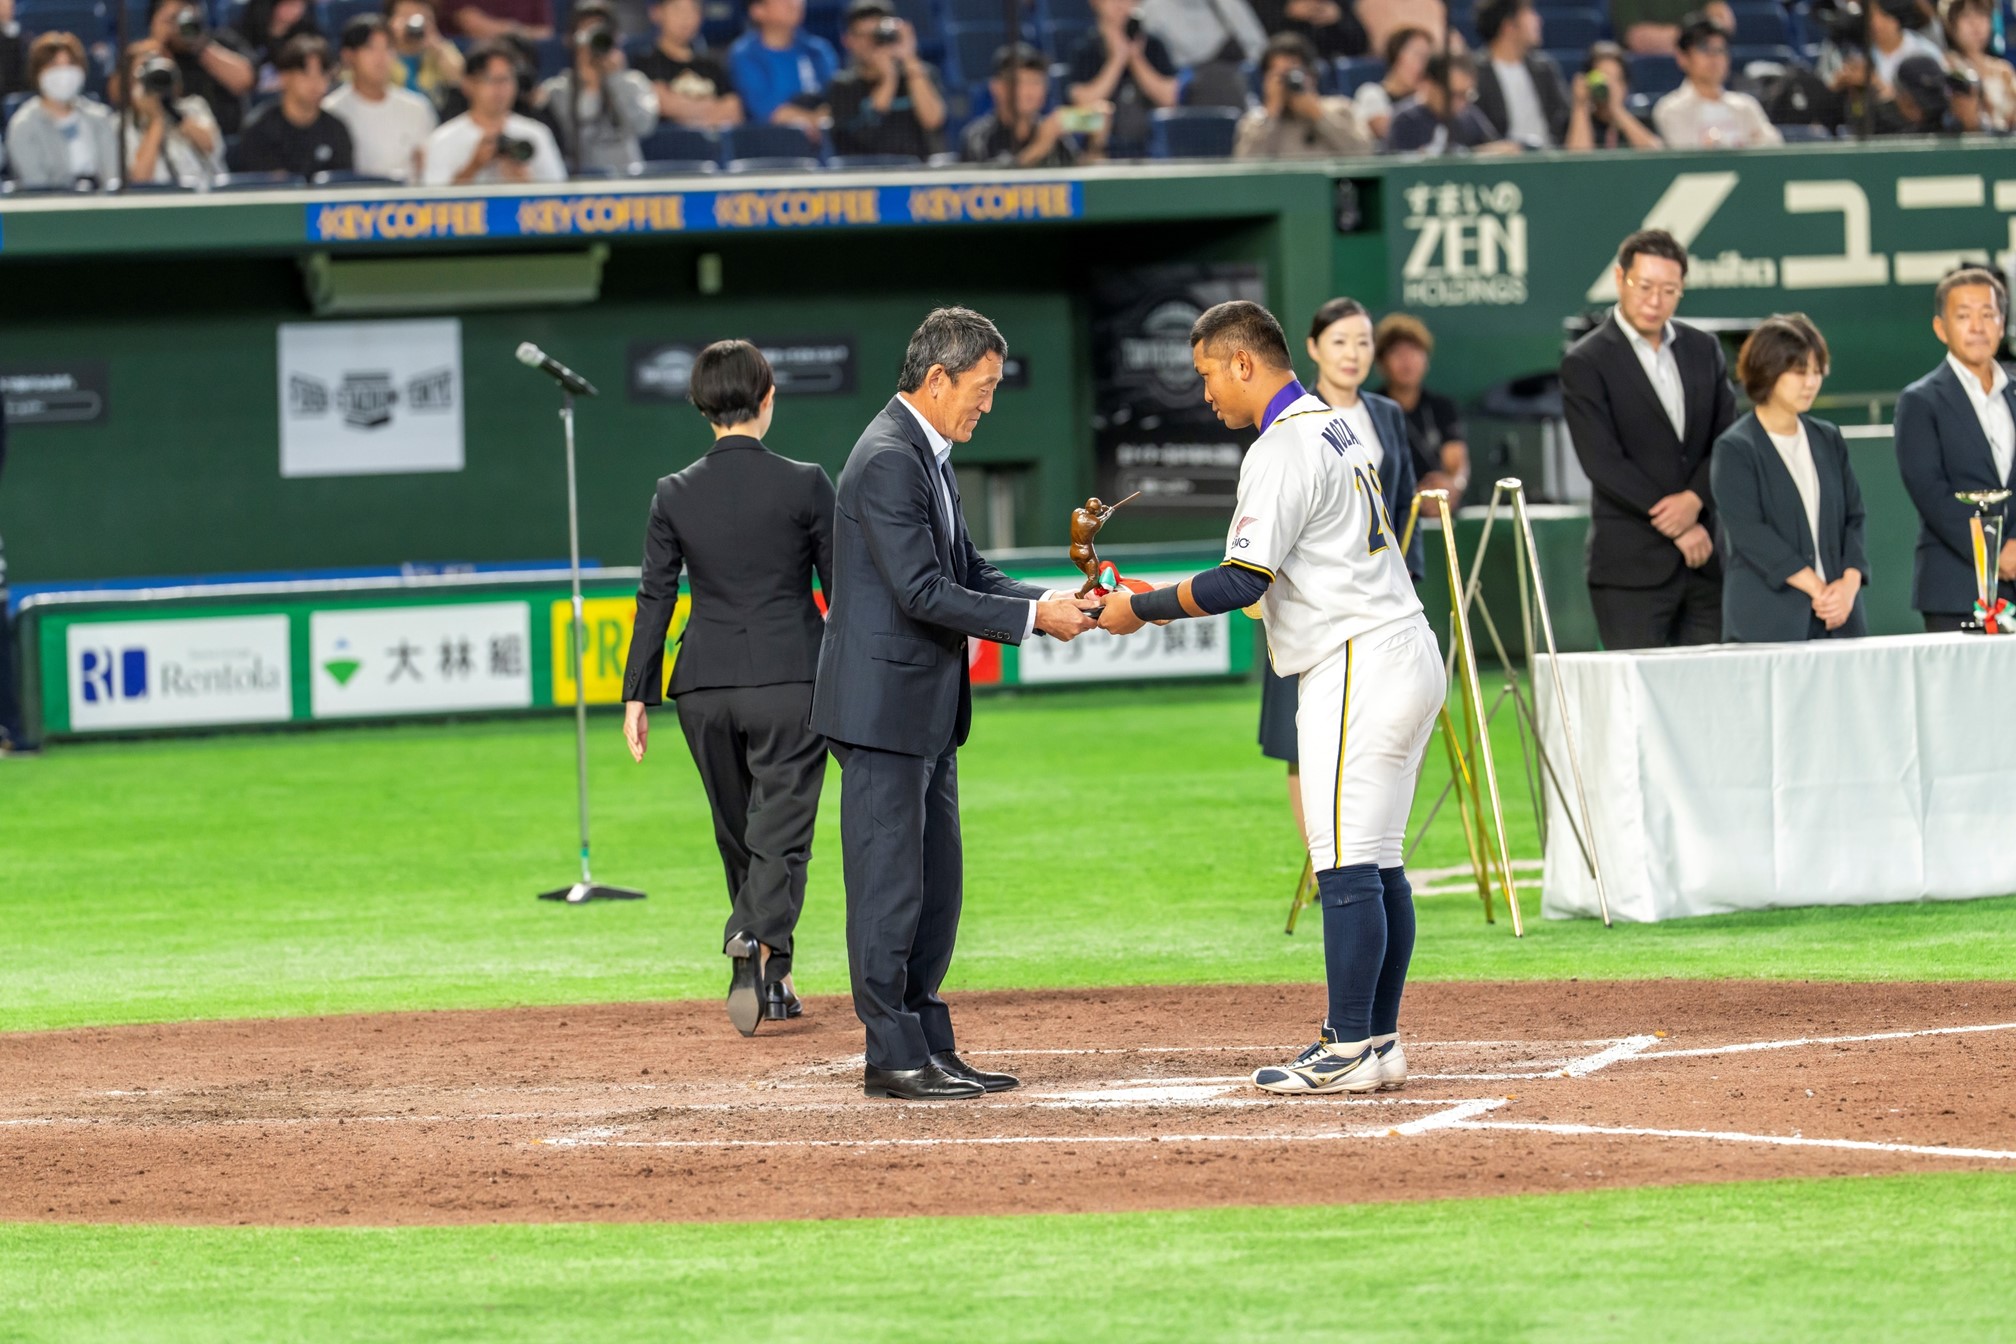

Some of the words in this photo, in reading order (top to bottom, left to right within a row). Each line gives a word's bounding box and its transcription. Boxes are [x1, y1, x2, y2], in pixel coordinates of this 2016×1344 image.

[1402, 181, 1523, 215] すまいの
[1402, 214, 1528, 279] ZEN
[1321, 418, 1364, 457] NOZA
